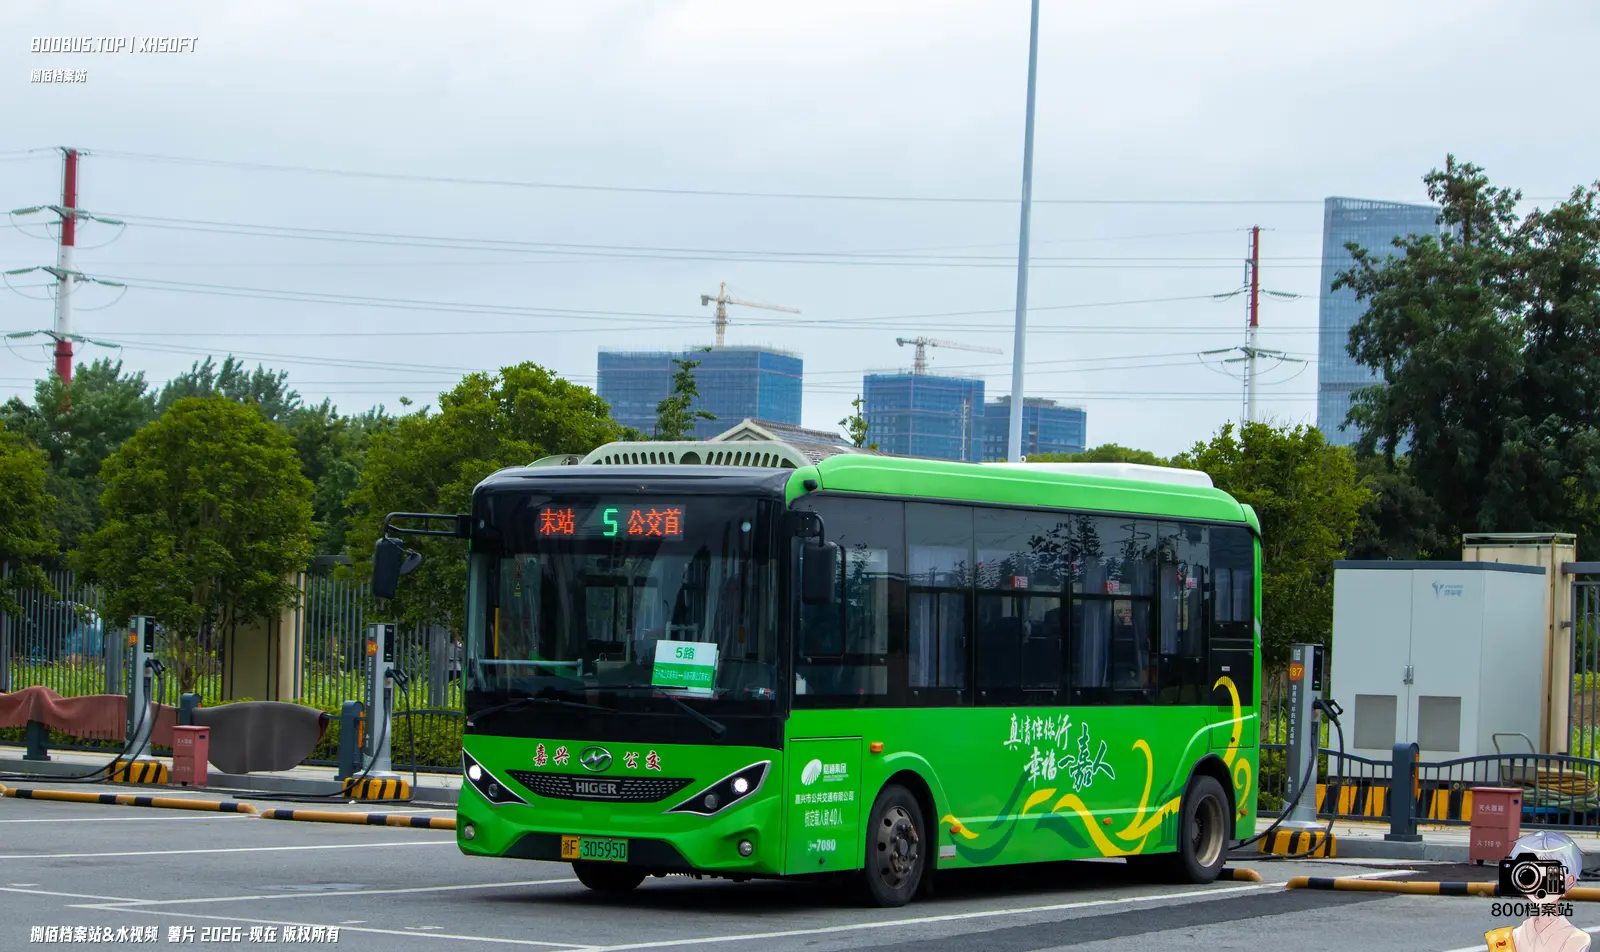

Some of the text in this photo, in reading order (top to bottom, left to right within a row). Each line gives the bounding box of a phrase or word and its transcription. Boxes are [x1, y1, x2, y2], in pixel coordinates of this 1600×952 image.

[540, 508, 682, 537] 末站 5 公交首
[675, 646, 695, 660] 5路
[1003, 712, 1072, 751] 真情伴你行
[532, 743, 662, 772] 嘉兴 公交
[575, 781, 618, 795] HIGER
